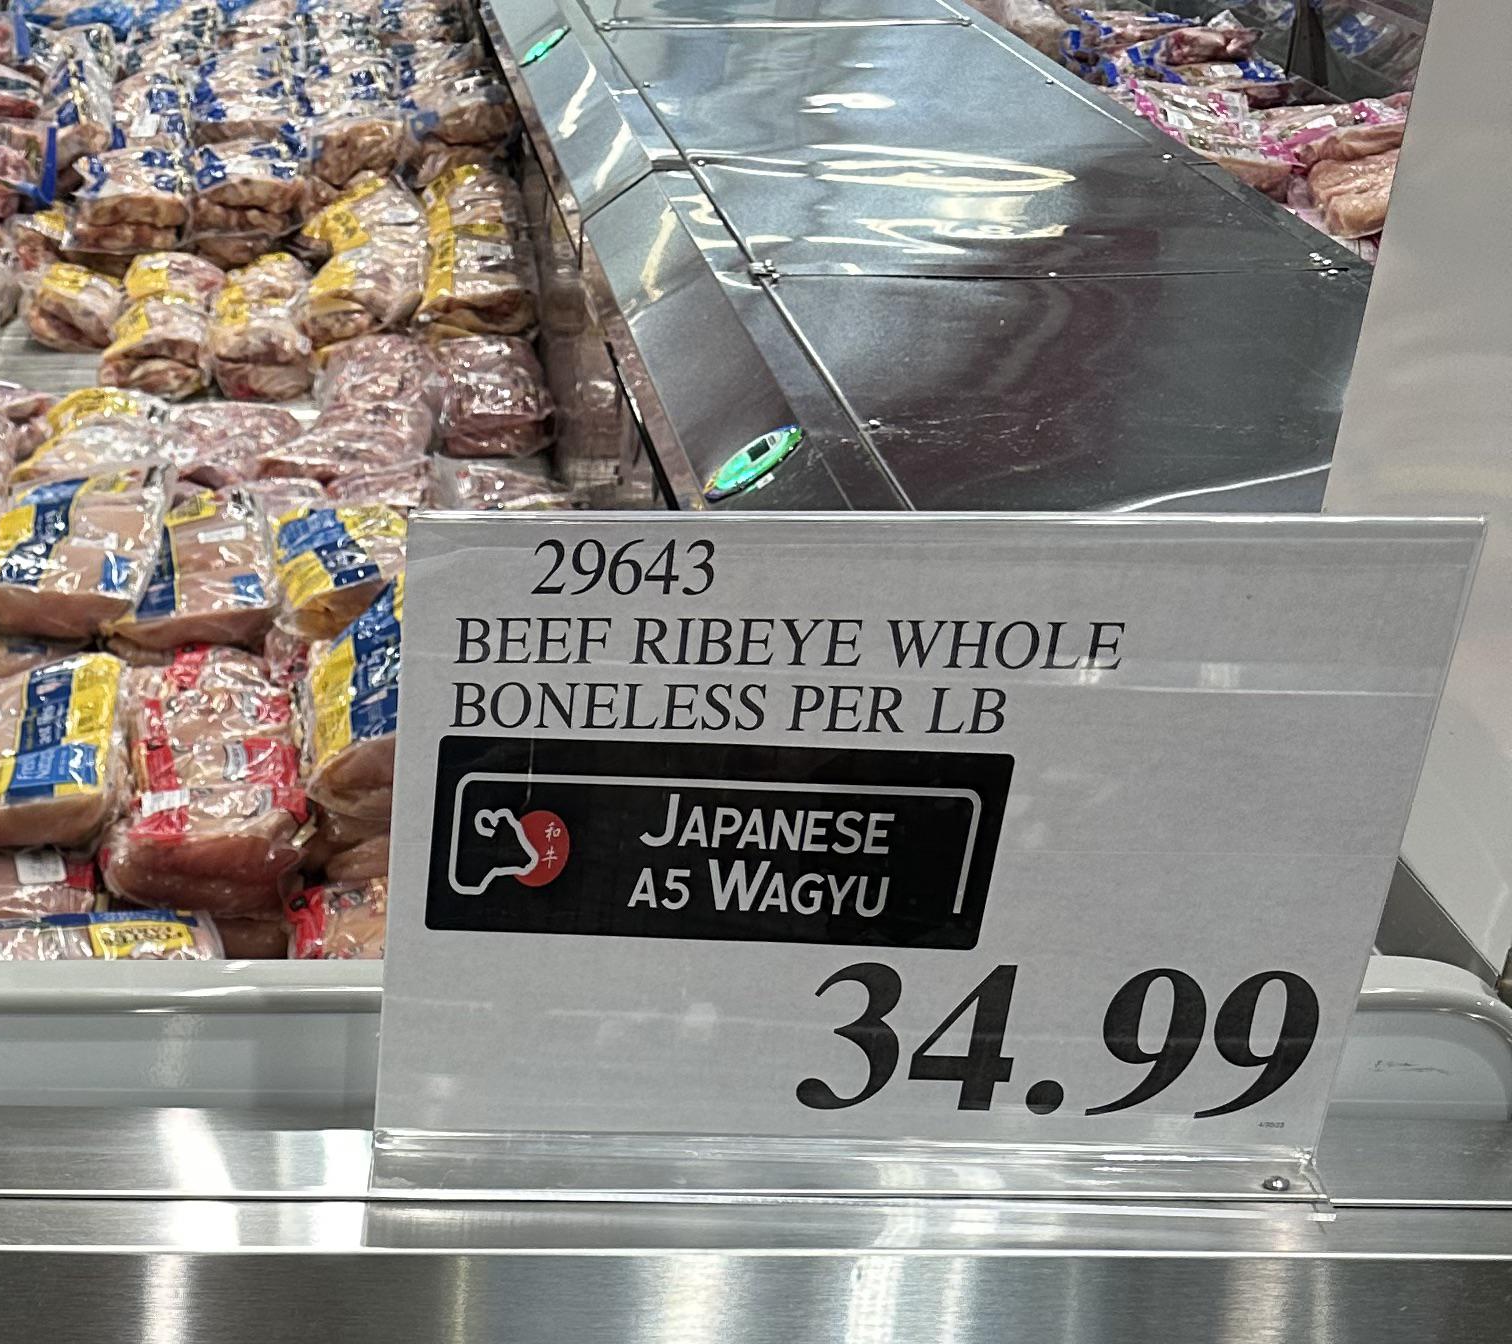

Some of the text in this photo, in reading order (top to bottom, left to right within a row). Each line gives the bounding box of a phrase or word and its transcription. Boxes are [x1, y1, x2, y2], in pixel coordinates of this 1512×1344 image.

[531, 539, 716, 596] 29643
[453, 617, 1127, 673] BEEF RIBEYE WHOLE
[449, 682, 1008, 735] BONELESS PER LB
[639, 793, 896, 854] JAPANESE
[627, 860, 890, 917] A5 WAGYU
[795, 961, 1321, 1119] 34.99
